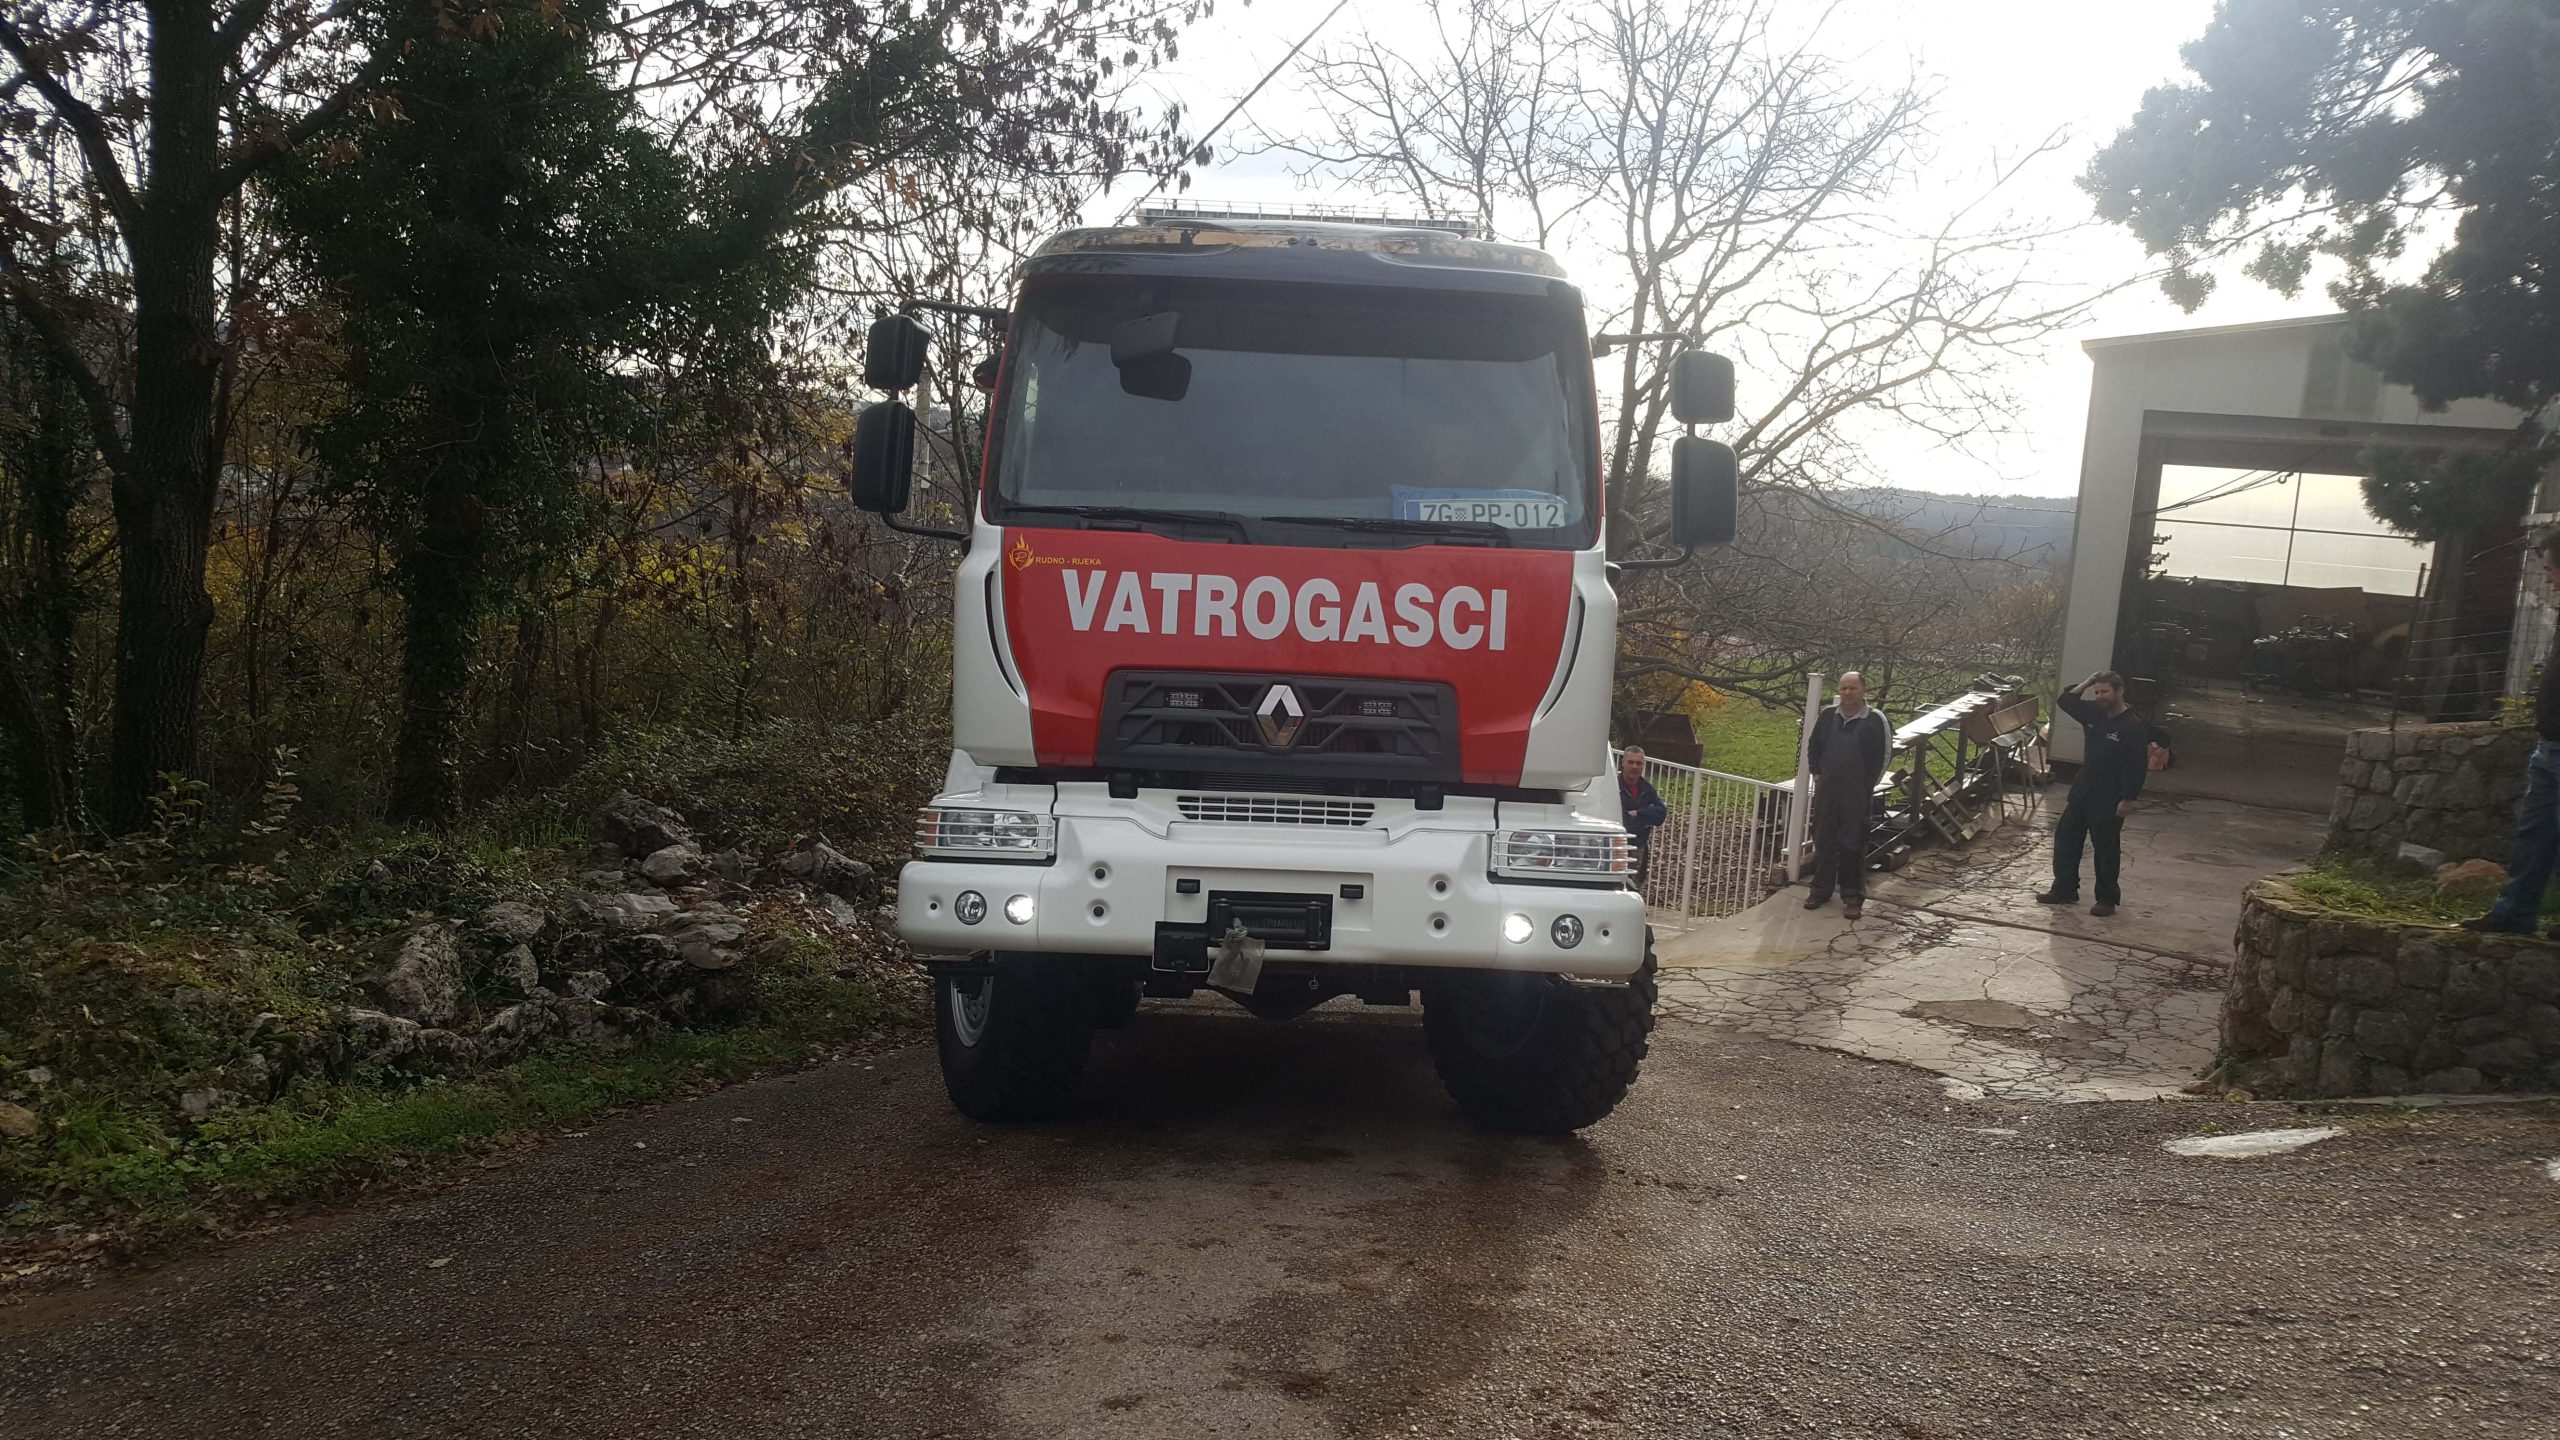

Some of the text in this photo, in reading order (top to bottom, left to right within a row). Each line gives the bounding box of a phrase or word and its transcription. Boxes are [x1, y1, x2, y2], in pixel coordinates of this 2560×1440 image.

[1423, 503, 1559, 527] ZG PP-012
[1035, 556, 1065, 565] RUDNO
[1071, 557, 1102, 566] RIJEKA
[1062, 569, 1508, 651] VATROGASCI
